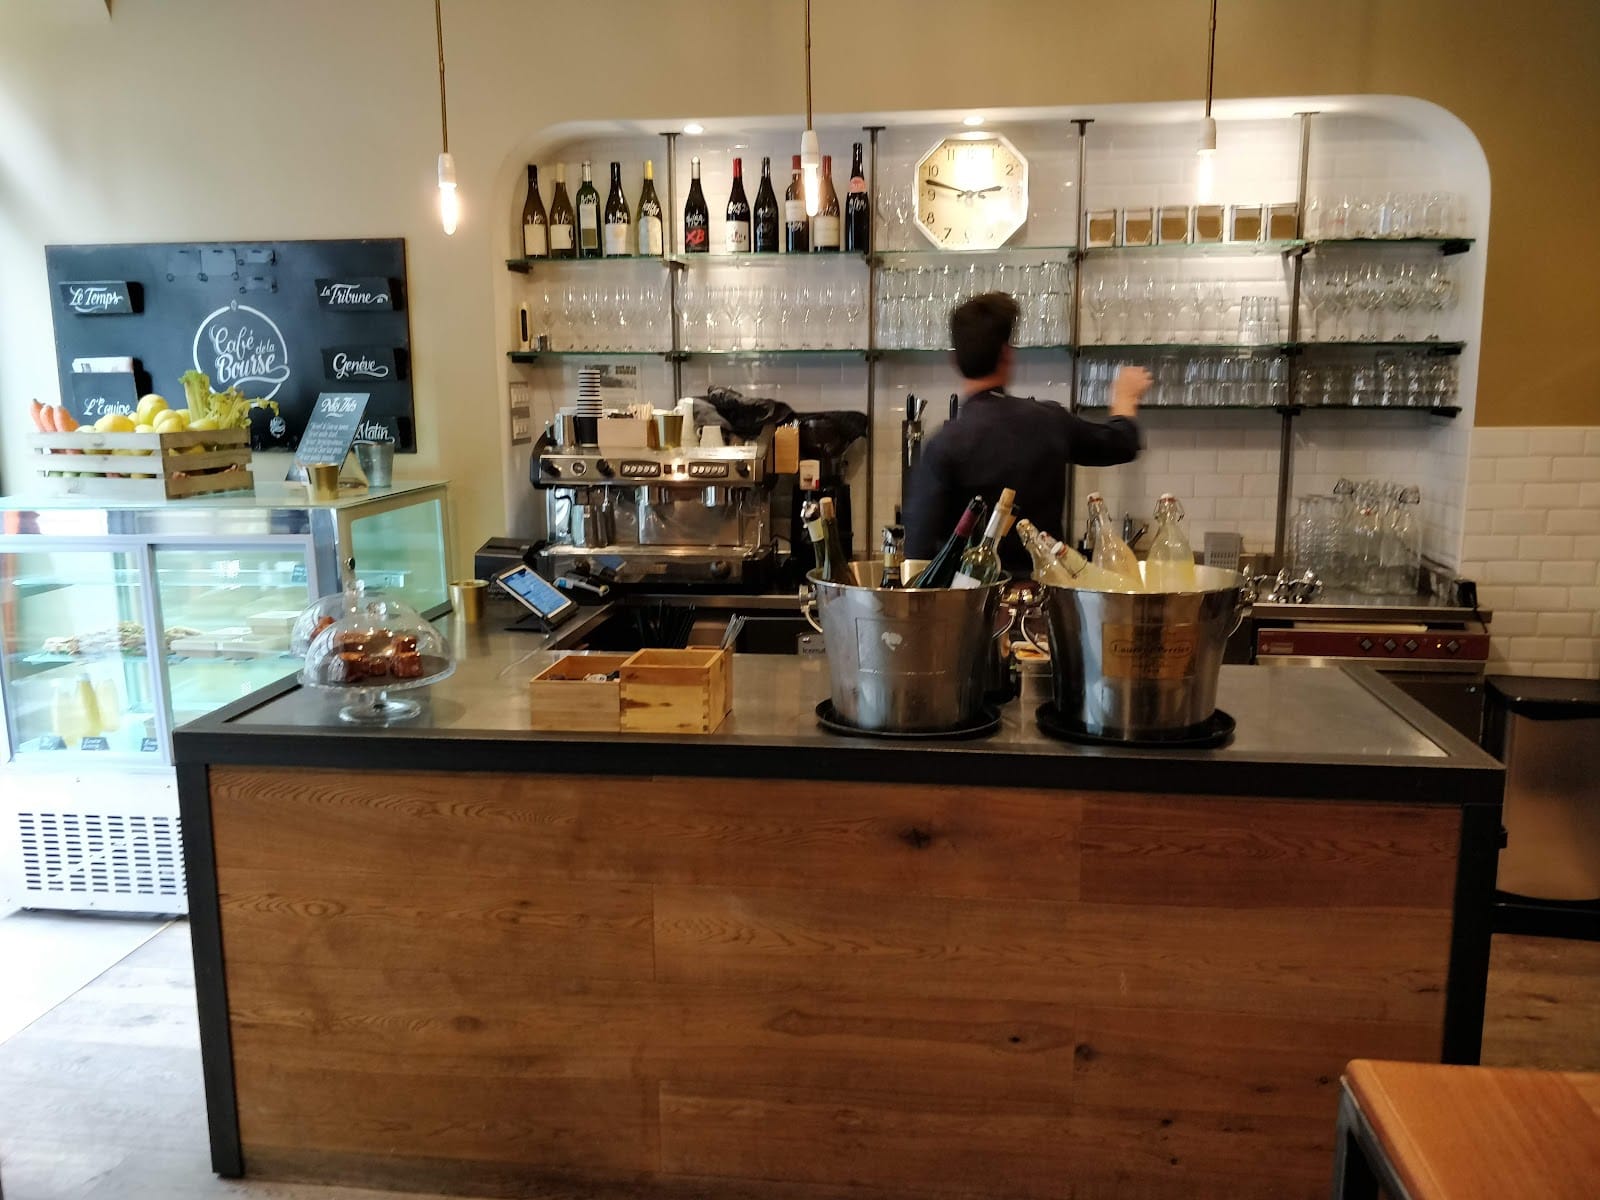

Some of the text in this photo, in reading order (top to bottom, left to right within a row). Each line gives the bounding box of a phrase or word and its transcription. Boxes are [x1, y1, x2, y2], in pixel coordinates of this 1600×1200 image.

[947, 148, 955, 160] 11
[928, 165, 939, 176] 10
[1005, 164, 1014, 176] 2
[927, 190, 936, 201] 9
[926, 212, 935, 224] 8
[943, 227, 952, 239] 7
[69, 286, 123, 310] Le Temps
[329, 283, 378, 305] Tribune
[209, 324, 254, 361] Café
[215, 353, 285, 385] Bourse
